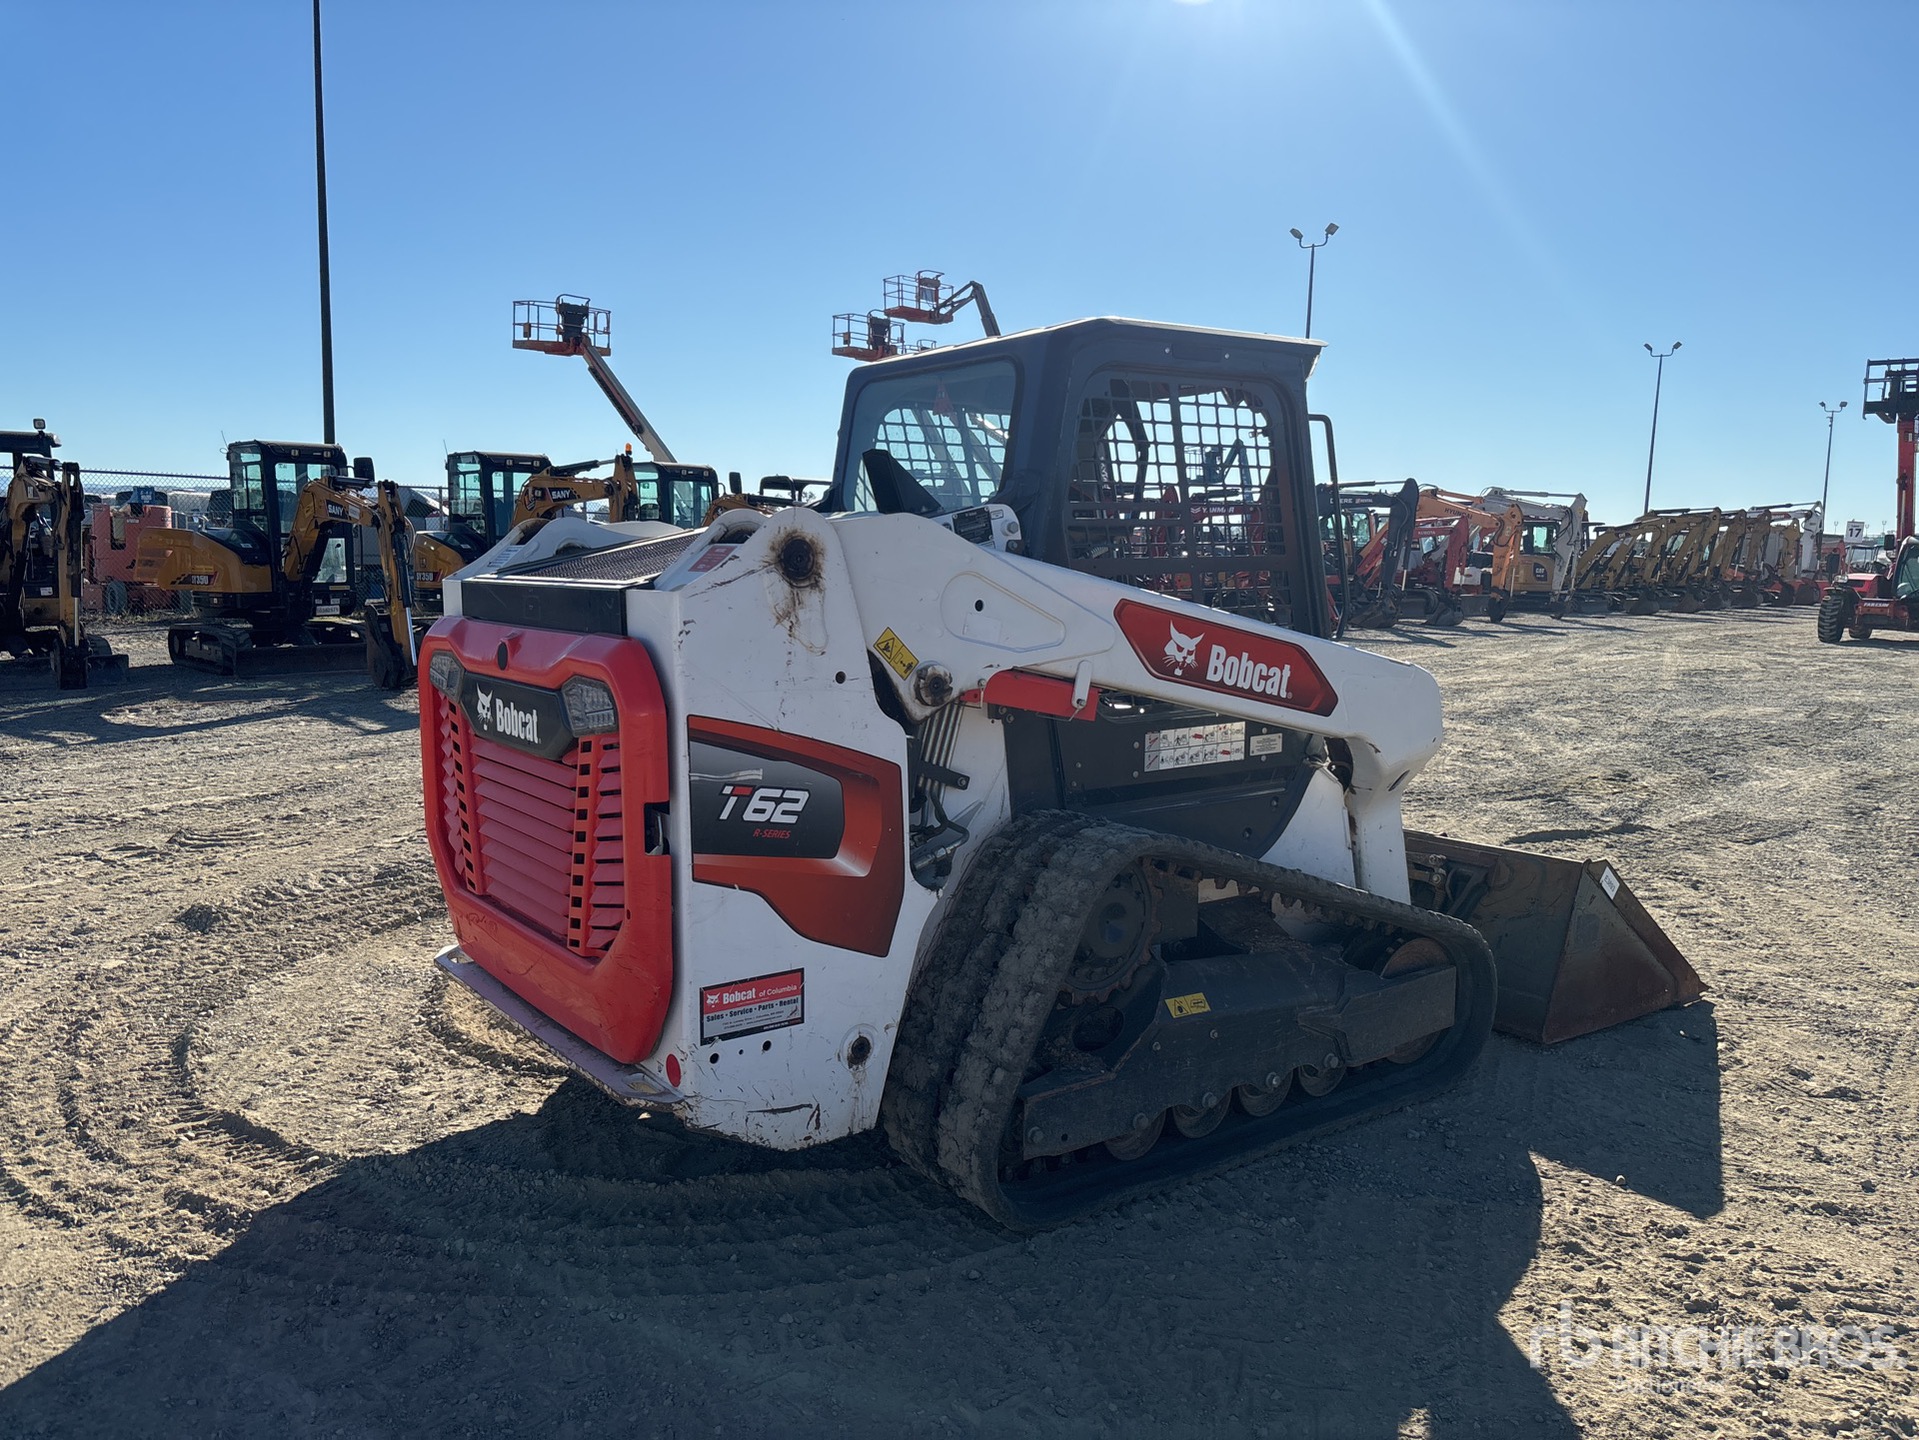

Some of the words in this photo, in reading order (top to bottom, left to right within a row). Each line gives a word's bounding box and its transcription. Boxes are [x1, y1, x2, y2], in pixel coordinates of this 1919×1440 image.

[551, 487, 571, 499] SANY
[327, 503, 344, 516] SANY
[1848, 528, 1862, 538] 17
[1206, 644, 1291, 698] Bobcat
[495, 698, 539, 744] Bobcat
[719, 785, 810, 824] T62
[753, 829, 791, 839] R-SERIES
[722, 988, 756, 1004] Bobcat
[767, 985, 798, 996] Columbia
[706, 1013, 724, 1022] Sales
[729, 1006, 753, 1018] Service
[758, 1002, 774, 1012] Parts
[779, 997, 799, 1006] Rental
